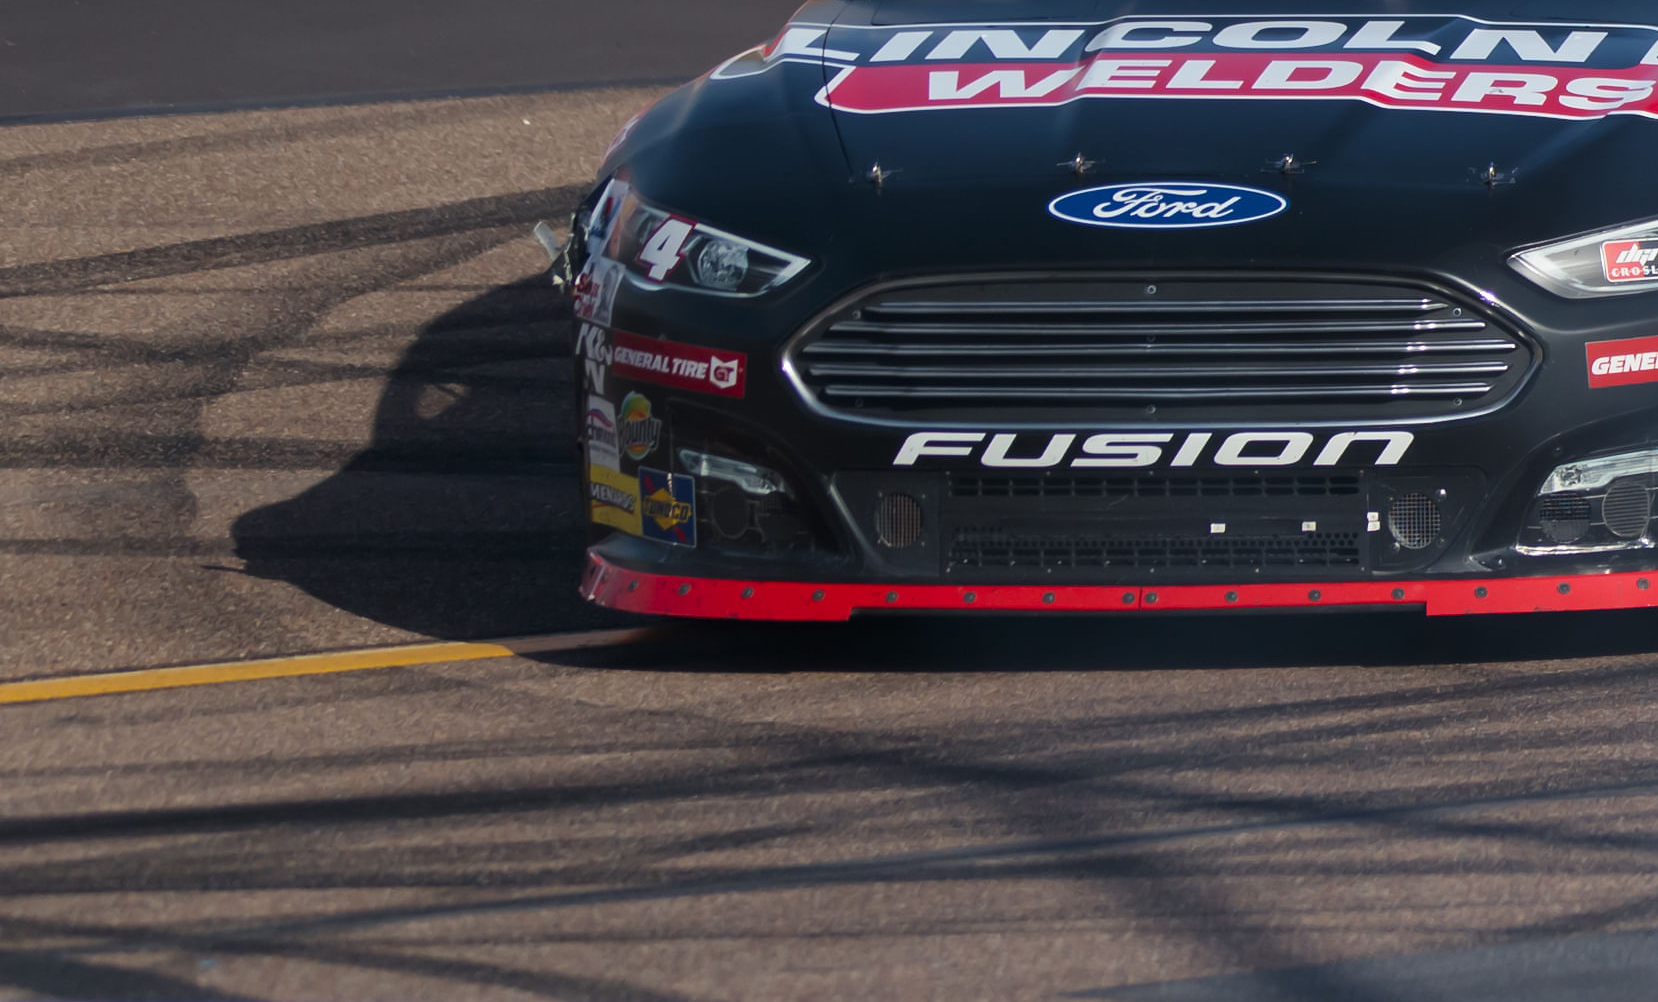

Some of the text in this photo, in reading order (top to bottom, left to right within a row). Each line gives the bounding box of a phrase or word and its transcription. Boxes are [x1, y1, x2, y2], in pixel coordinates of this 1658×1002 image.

[772, 21, 1608, 62] LINCOLN
[929, 60, 1656, 110] WELDERS
[1093, 189, 1241, 219] Ford
[641, 218, 693, 280] 4
[614, 347, 669, 373] GENERAL
[672, 358, 708, 379] TIRE
[893, 432, 1415, 467] FUSION
